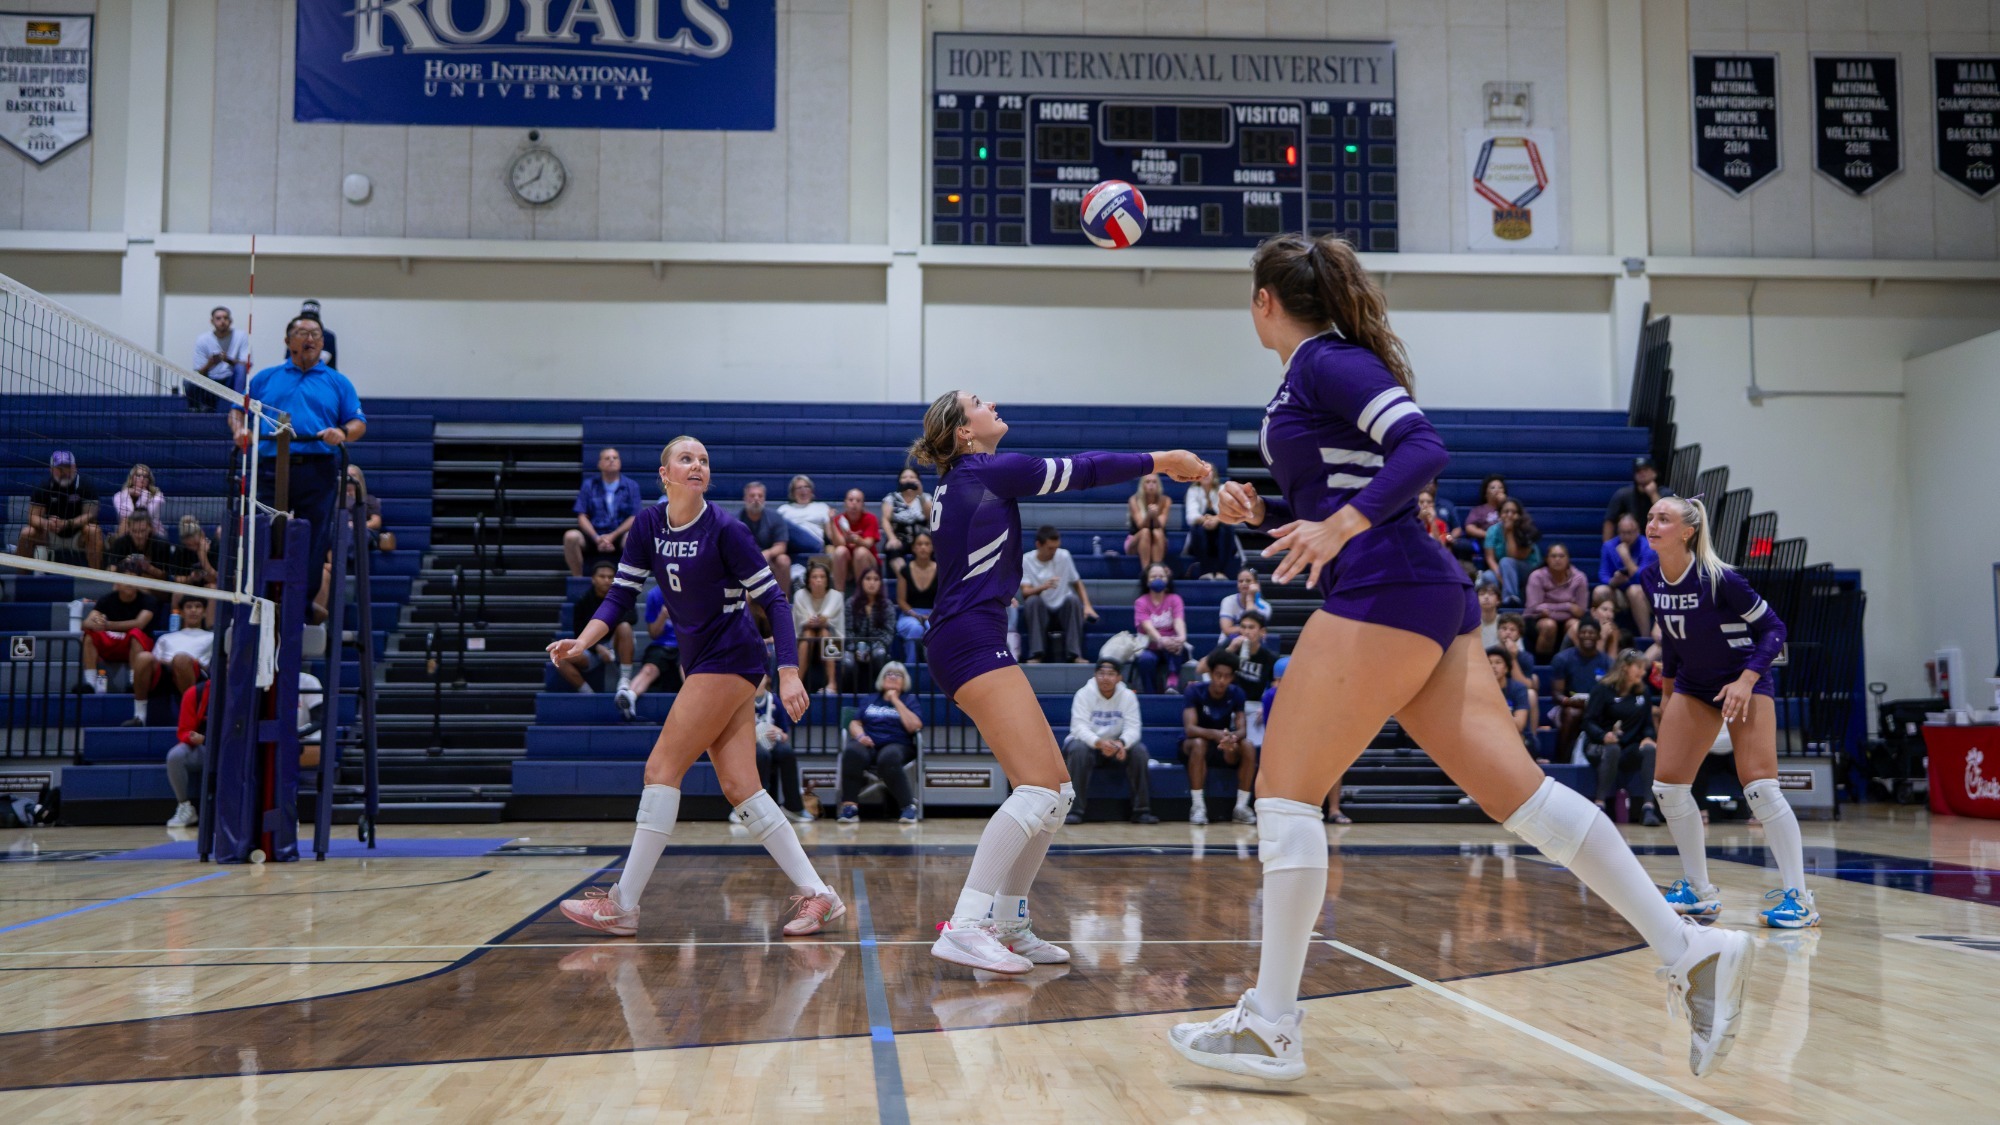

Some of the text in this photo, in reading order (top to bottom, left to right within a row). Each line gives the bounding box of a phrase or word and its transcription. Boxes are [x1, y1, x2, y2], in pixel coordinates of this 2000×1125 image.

[424, 60, 652, 82] HOPE INTERNATIONAL
[948, 48, 1383, 85] HOPE INTERNATIONAL UNIVERSITY
[1715, 61, 1753, 79] NAIA
[1836, 62, 1874, 80] NAIA
[0, 66, 88, 84] CHAMPIONS
[19, 86, 66, 98] WOMEN'S
[424, 81, 653, 101] UNIVERSITY
[1711, 81, 1758, 95] NATIONAL
[1832, 82, 1880, 95] NATIONAL
[6, 100, 77, 112] BASKETBALL
[974, 96, 984, 108] F
[998, 96, 1023, 109] PTS
[1346, 102, 1356, 115] F
[1369, 102, 1394, 116] PTS
[1824, 97, 1889, 111] INVITATIONAL
[1039, 102, 1090, 121] HOME
[1235, 106, 1300, 125] VISITOR
[28, 115, 56, 127] 2014
[1704, 125, 1768, 140] BASKETBALL
[1825, 127, 1890, 141] VOLLEYBALL
[1946, 128, 2000, 141] BASKETBA
[1724, 141, 1750, 154] 2014
[1057, 166, 1100, 181] BONUS
[1131, 160, 1178, 174] PERIOD
[1233, 170, 1276, 184] BONUS
[1243, 191, 1282, 206] FOULS
[1147, 205, 1198, 220] MEOUTS
[1151, 218, 1182, 232] LEFT
[654, 537, 699, 558] YOTES
[666, 563, 682, 592] 6
[1653, 592, 1699, 610] YOTES
[1663, 614, 1686, 639] 17
